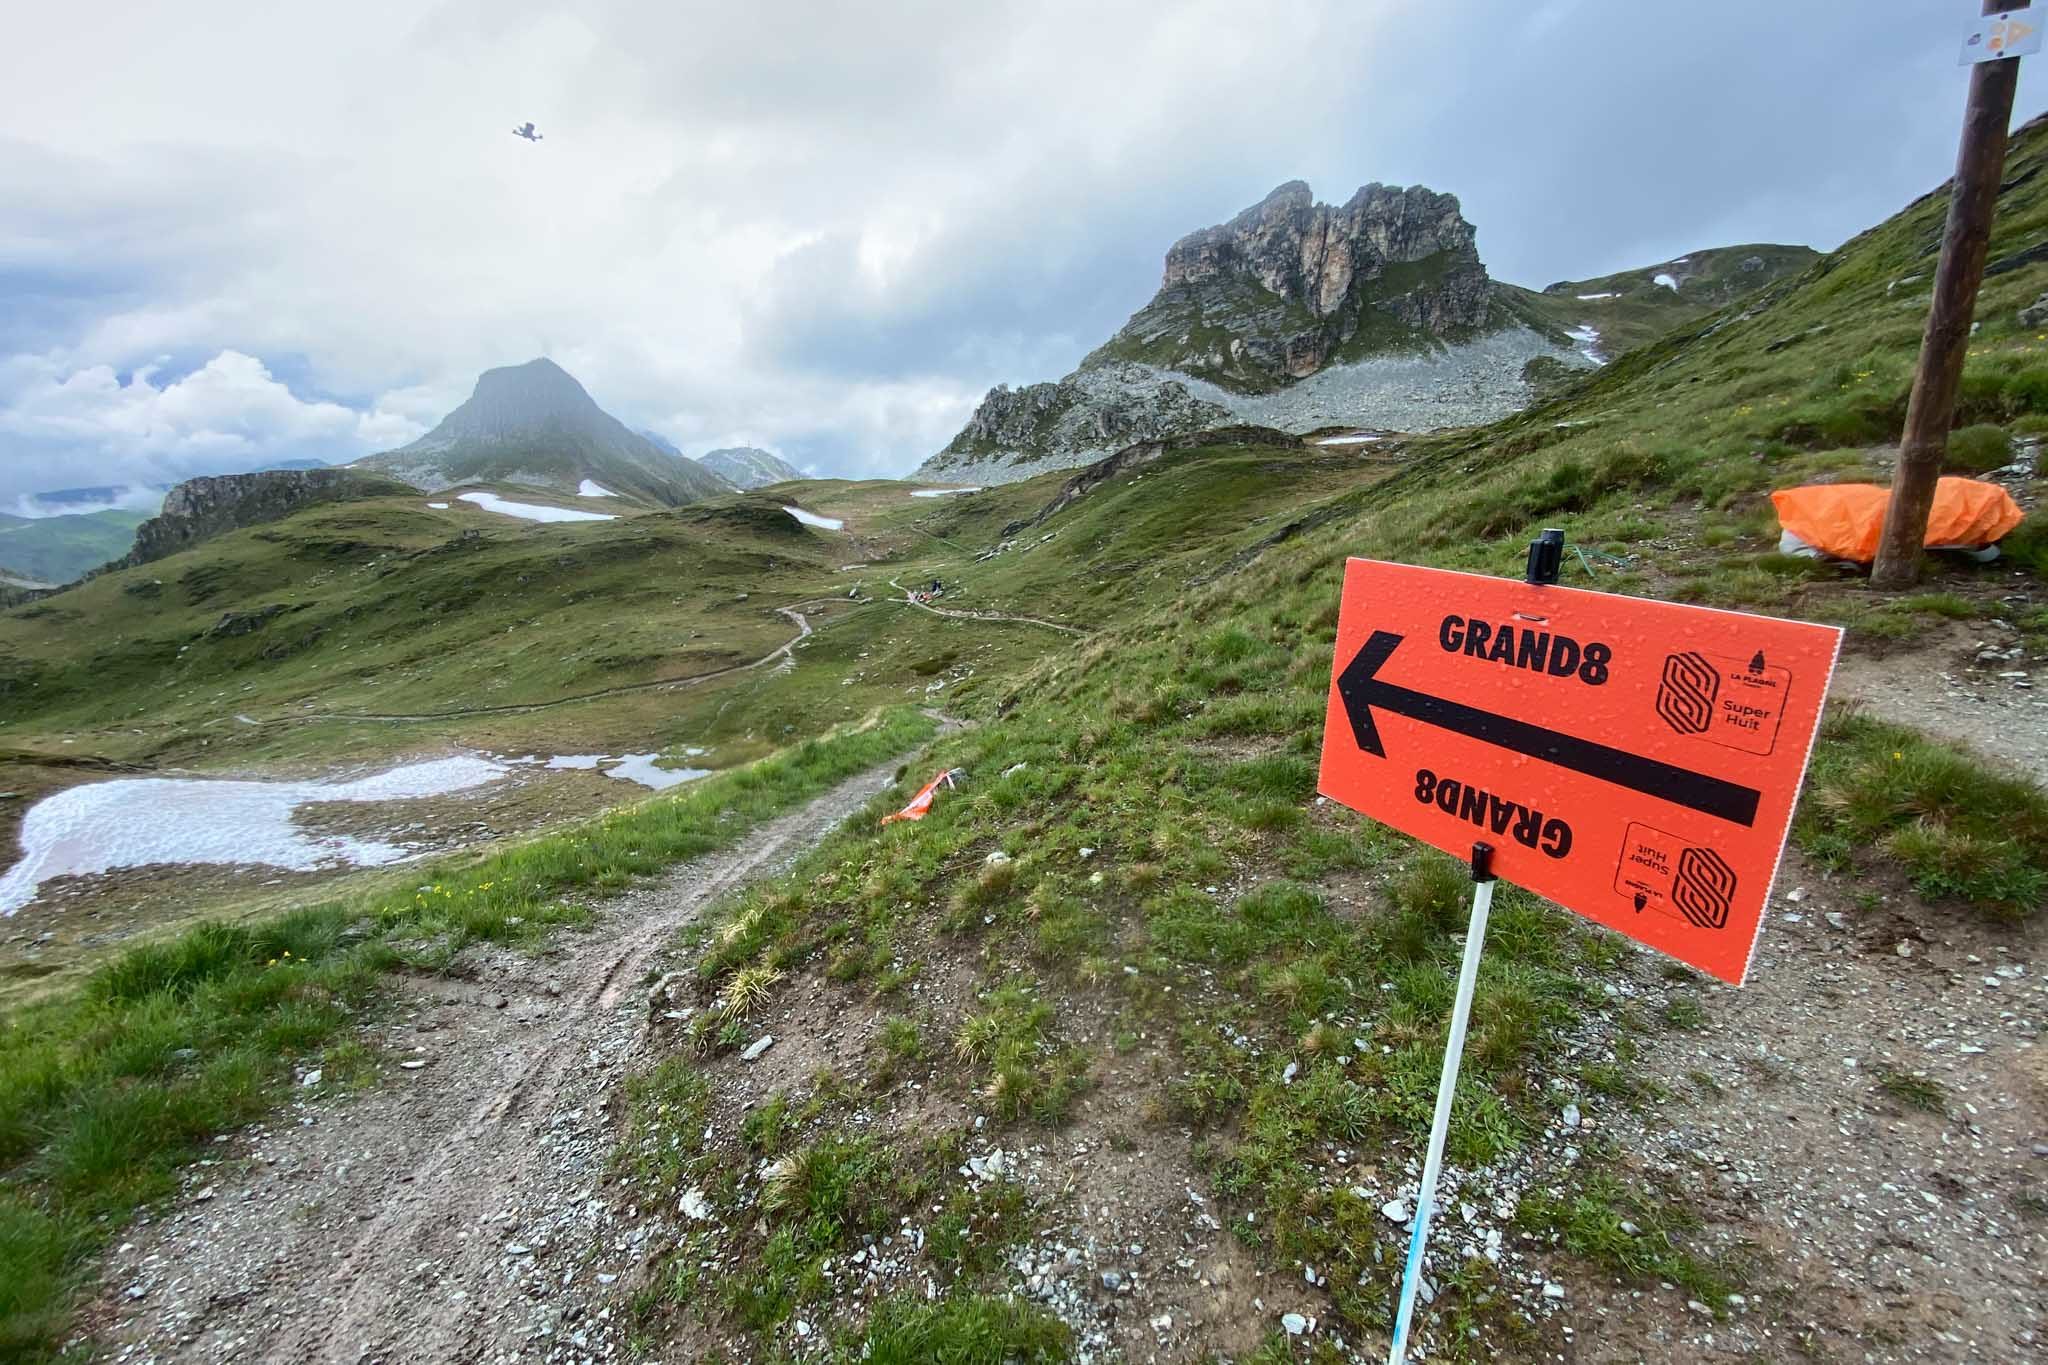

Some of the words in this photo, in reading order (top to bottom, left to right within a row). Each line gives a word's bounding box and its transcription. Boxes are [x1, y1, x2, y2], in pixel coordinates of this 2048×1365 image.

[1439, 614, 1612, 686] GRAND8
[1722, 700, 1771, 719] Super
[1726, 714, 1761, 731] Huit
[1414, 768, 1573, 859] GRAND8
[1638, 845, 1667, 862] Huit
[1630, 854, 1670, 876] Super
